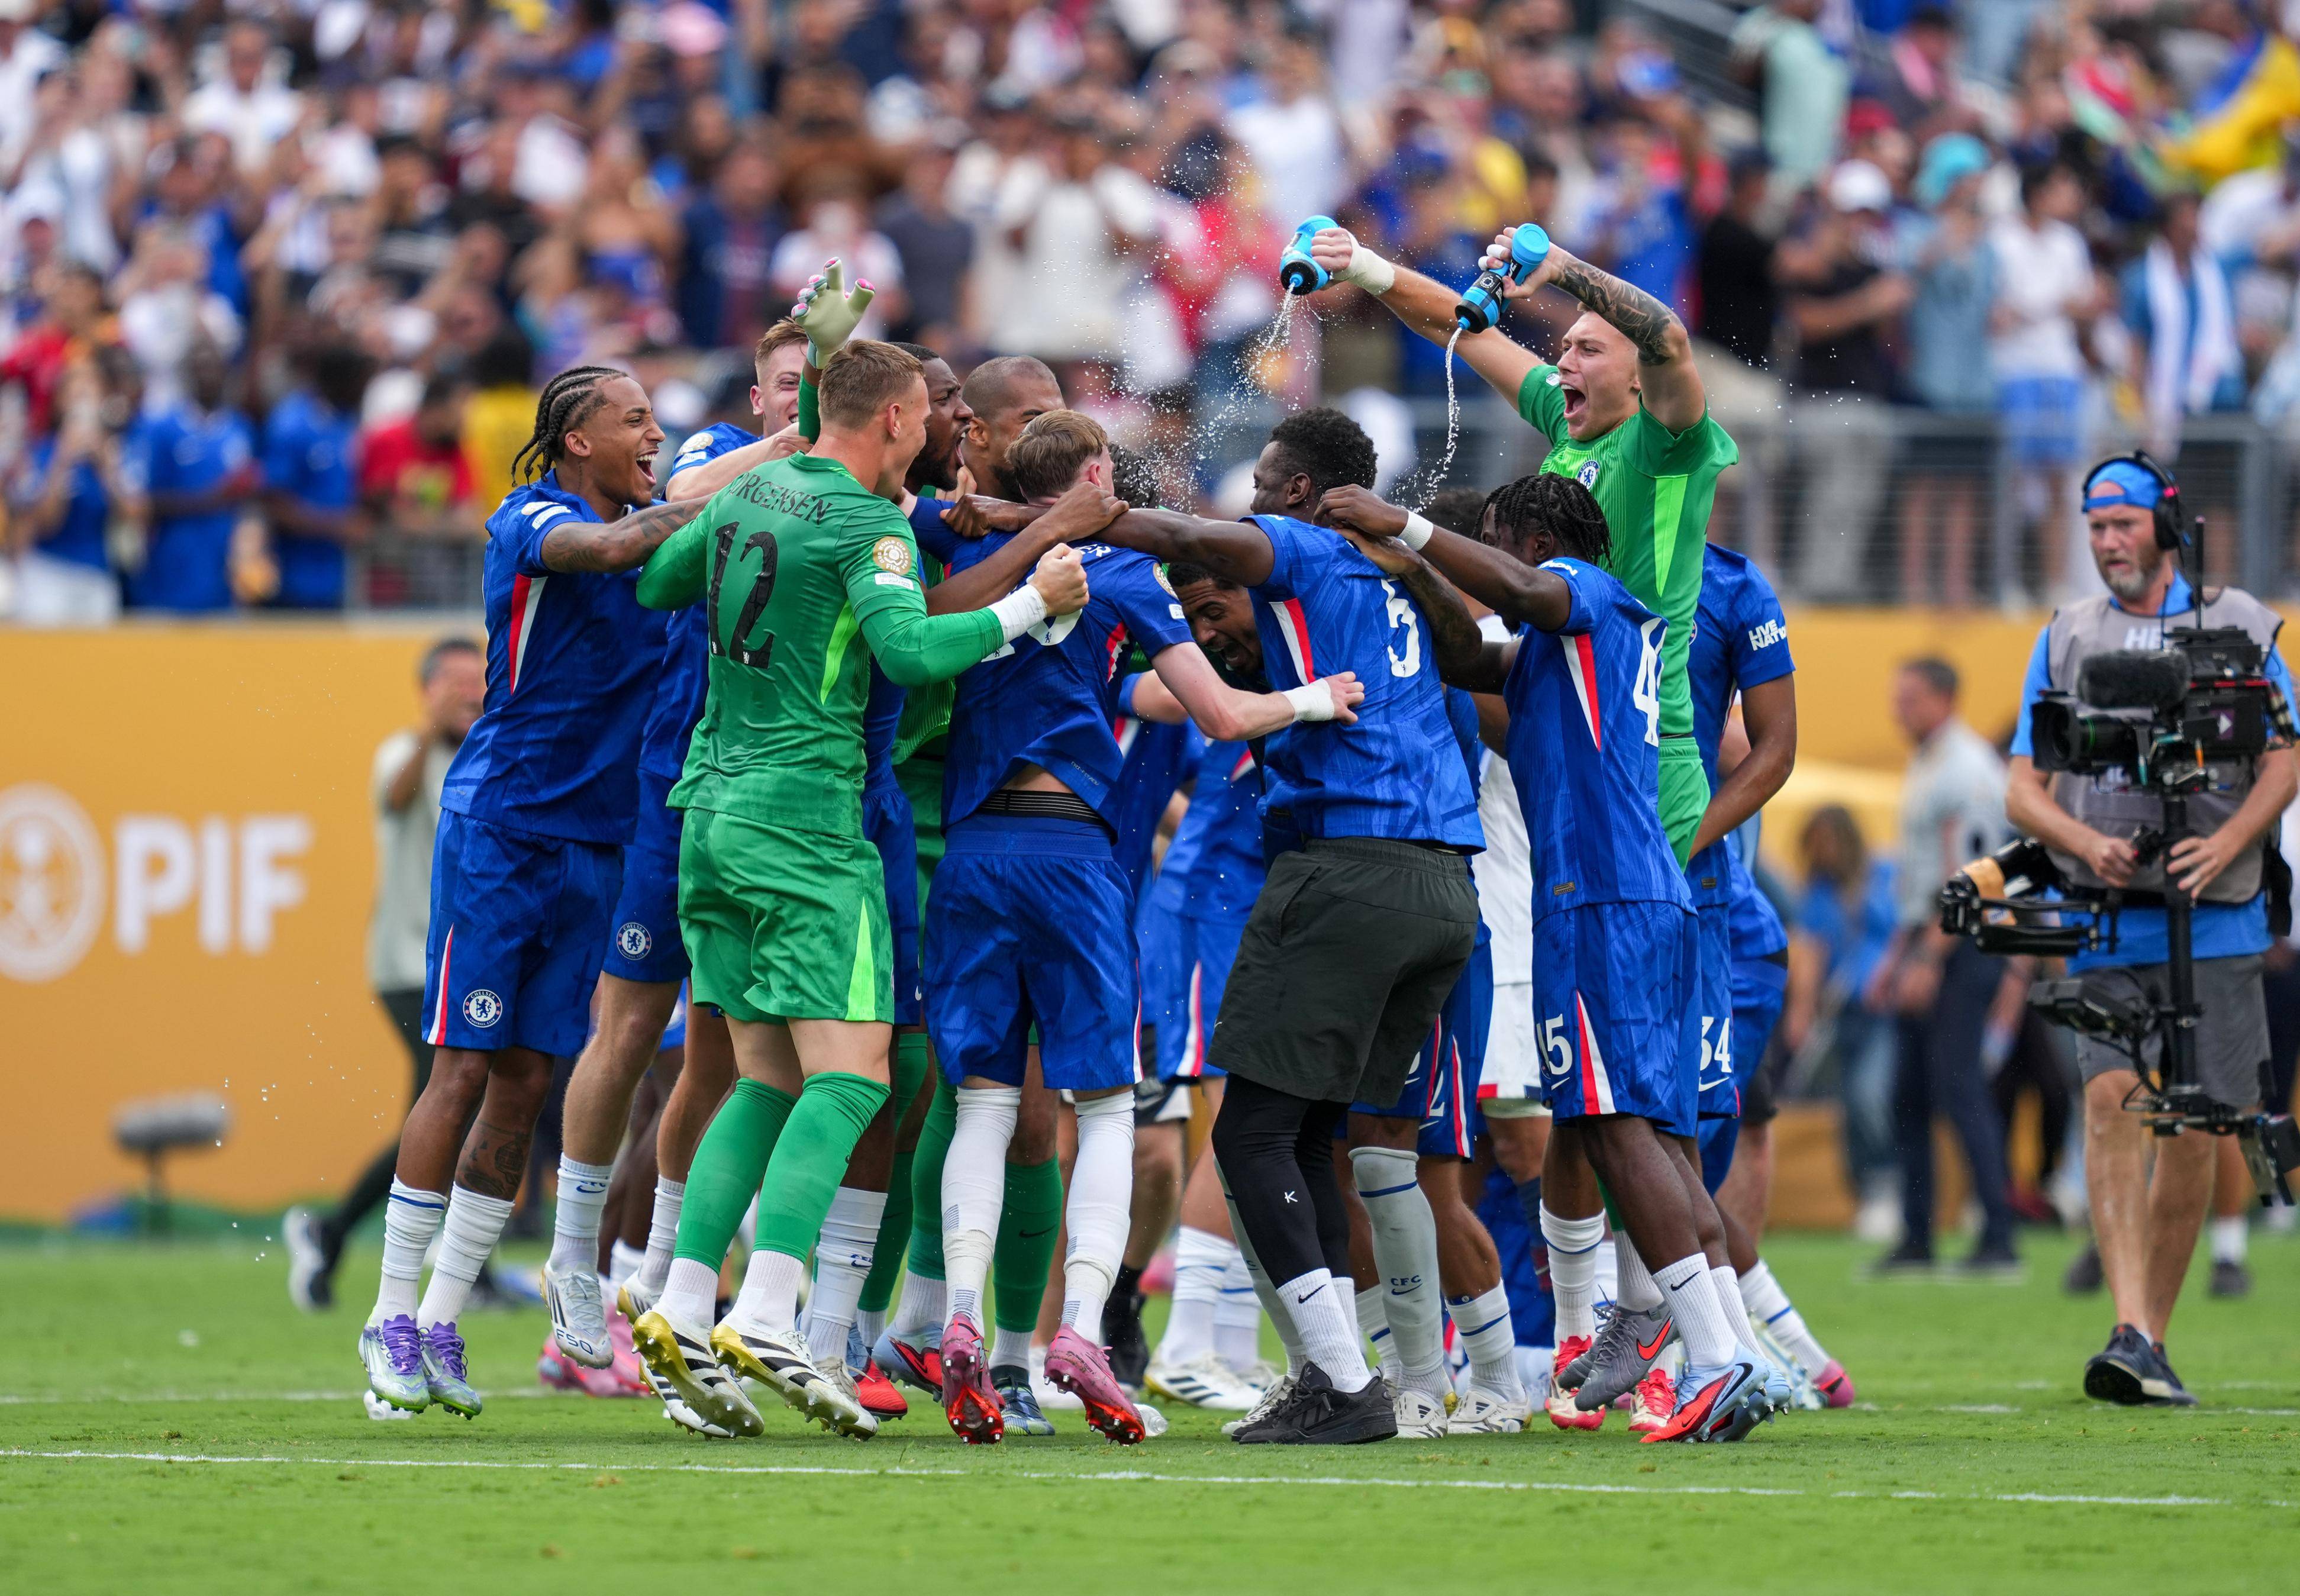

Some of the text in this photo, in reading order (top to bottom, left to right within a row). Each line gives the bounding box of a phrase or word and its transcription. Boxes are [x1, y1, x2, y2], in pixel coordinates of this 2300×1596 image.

[1580, 462, 1596, 472] CHELSEA
[879, 540, 895, 550] WORLD
[896, 542, 906, 551] CUP
[886, 563, 901, 572] FIFA
[708, 521, 778, 669] 12
[1381, 576, 1421, 678] 5
[1749, 619, 1778, 640] LIVE
[1751, 625, 1786, 651] NATIO
[114, 814, 313, 955] PIF
[623, 924, 645, 933] CHELSEA
[1391, 1275, 1422, 1286] CFC
